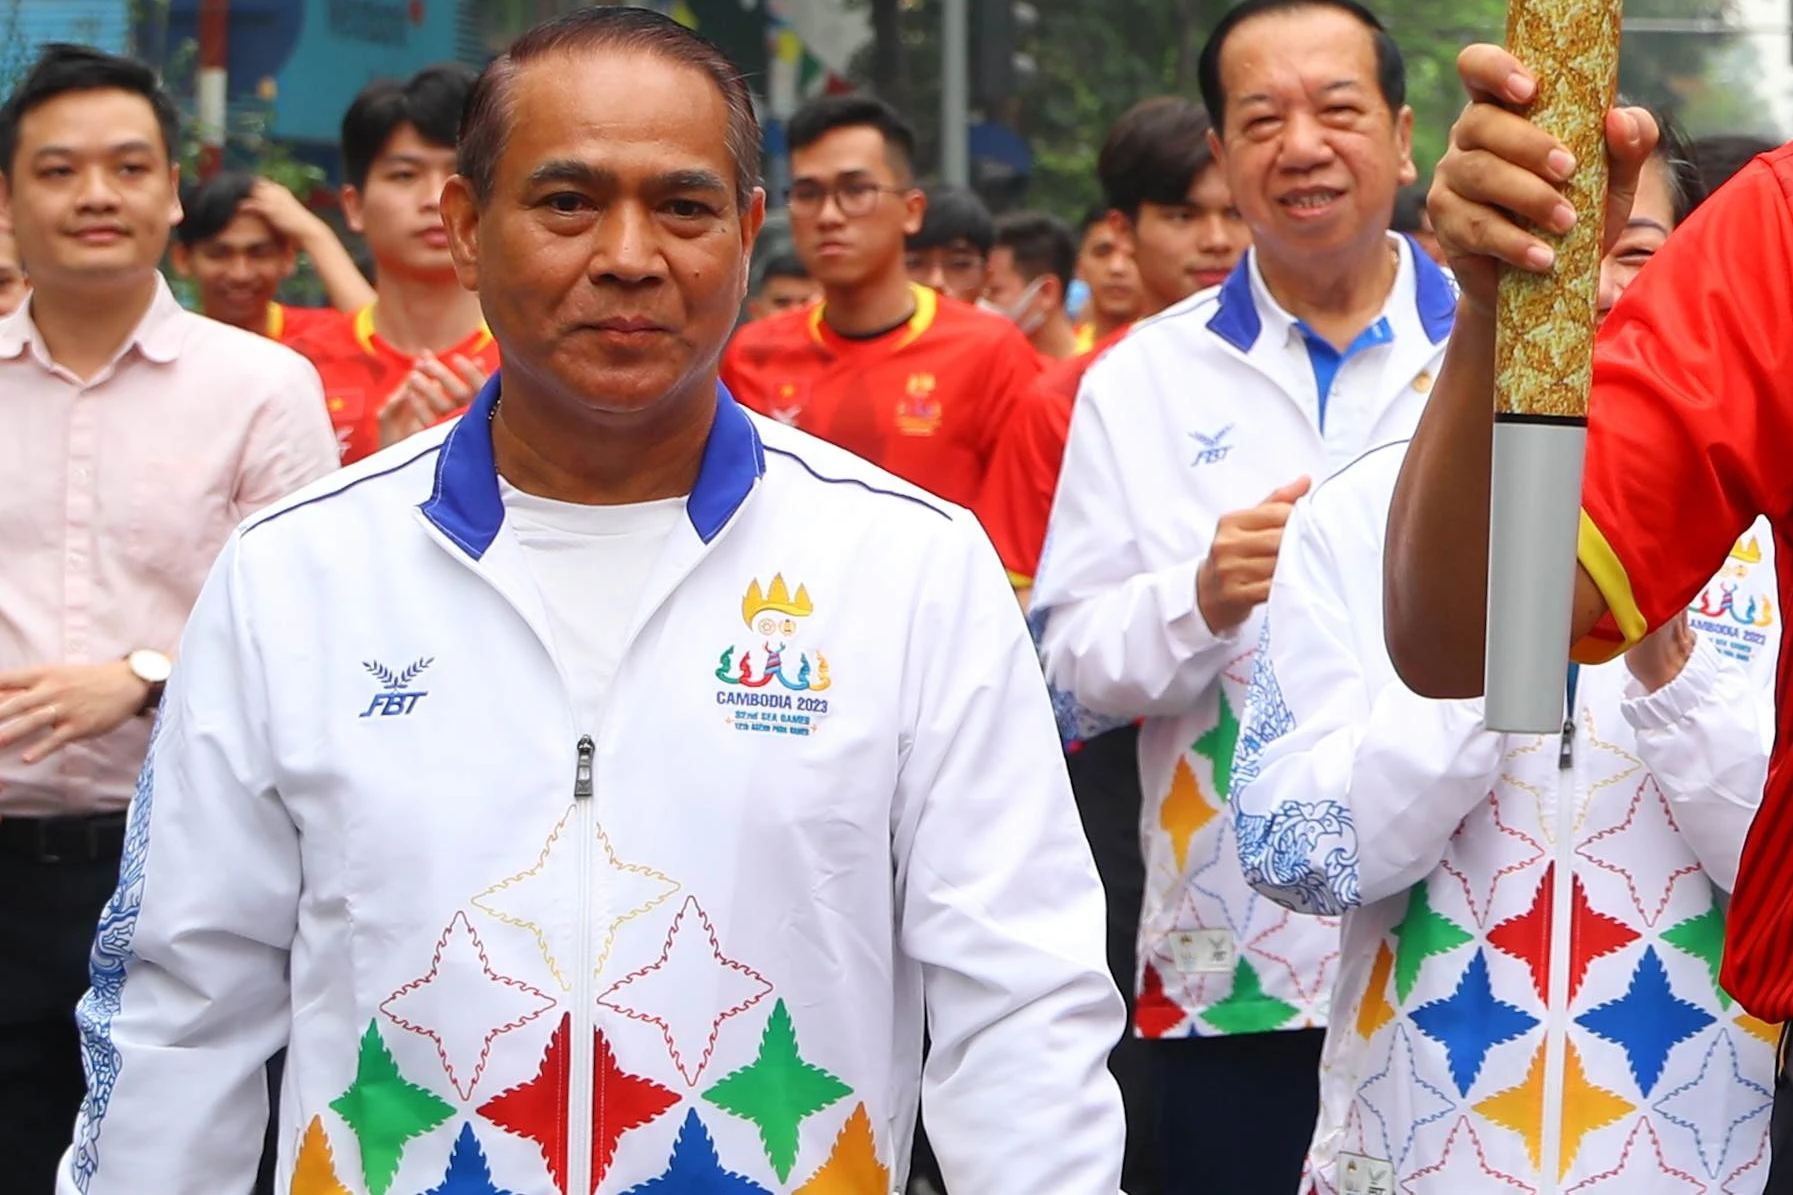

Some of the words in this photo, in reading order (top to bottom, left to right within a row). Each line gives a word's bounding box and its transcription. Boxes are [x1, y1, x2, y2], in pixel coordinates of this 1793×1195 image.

[1690, 619, 1738, 638] AMBODIA
[358, 690, 428, 718] FBT
[716, 691, 792, 710] CAMBODIA
[797, 697, 828, 714] 2023
